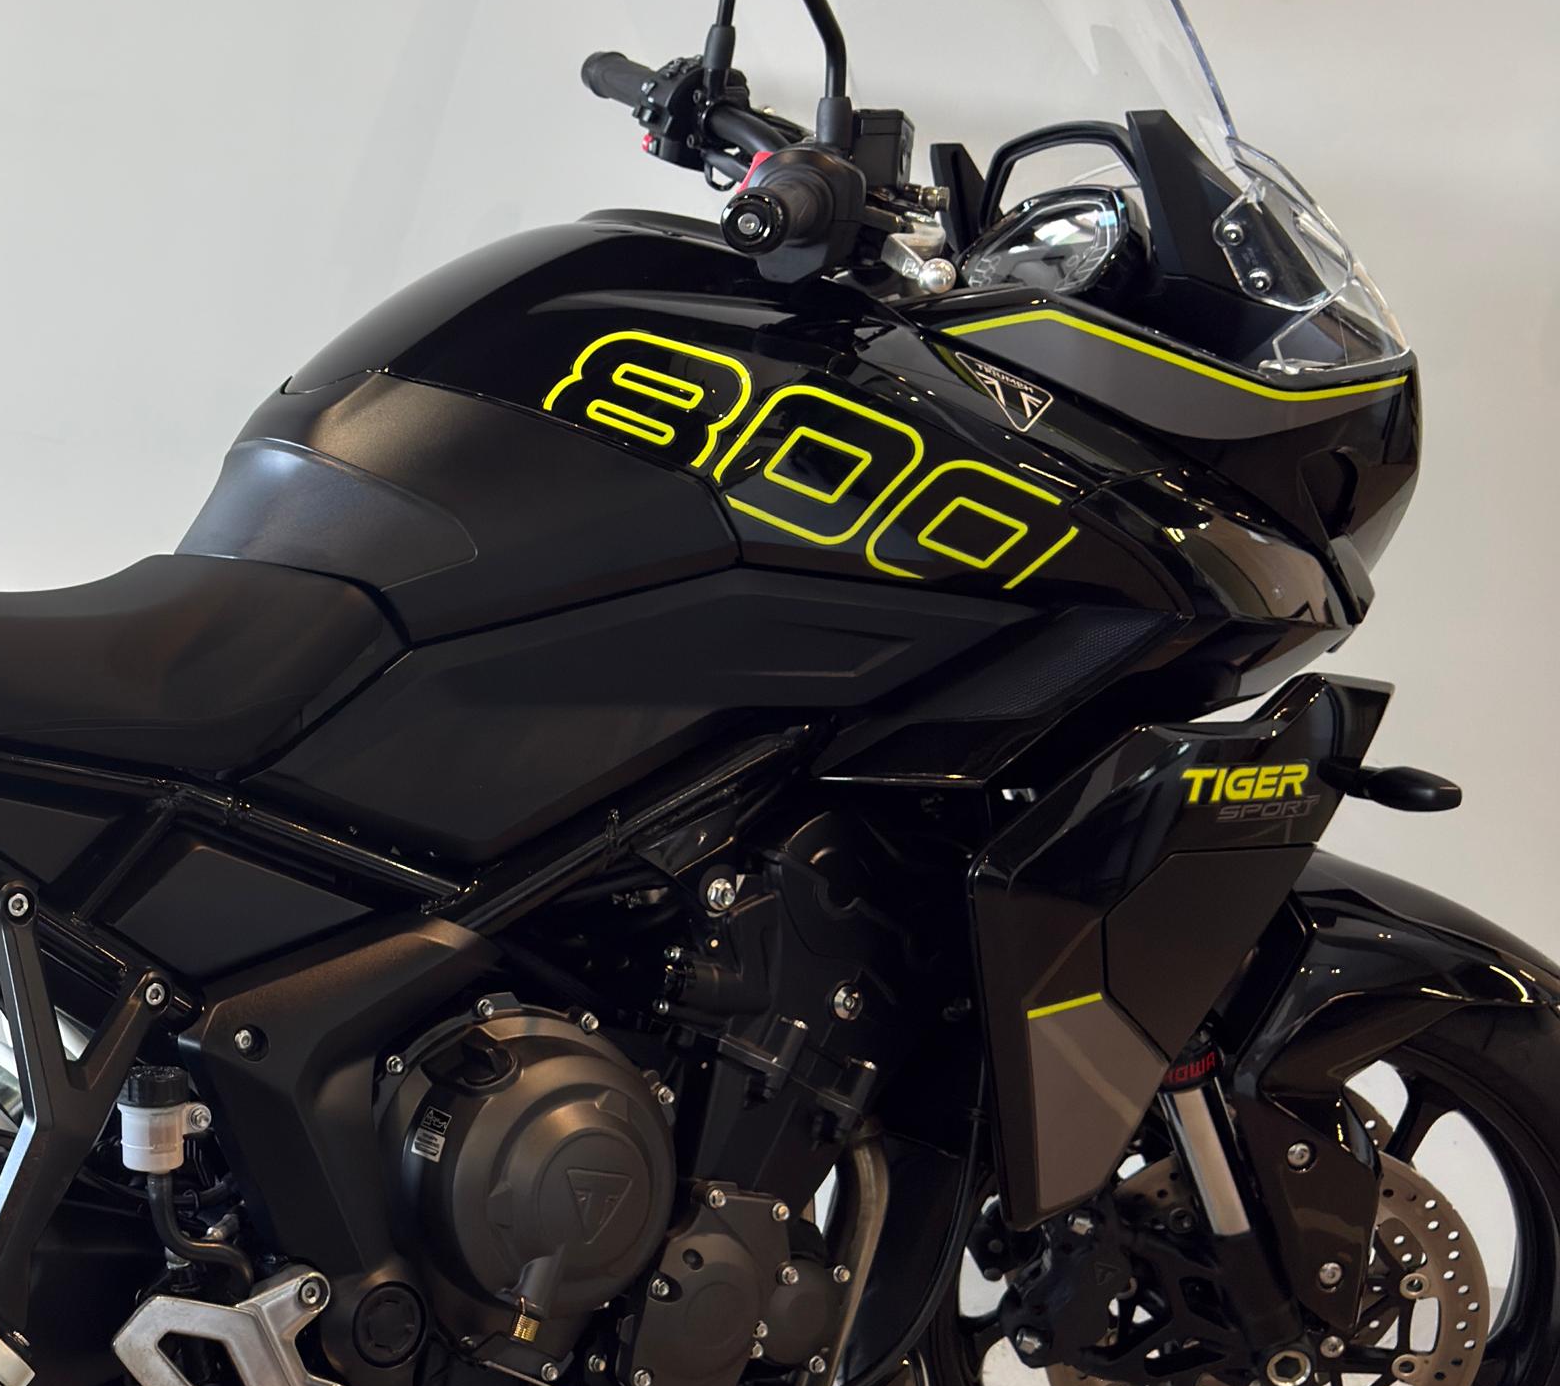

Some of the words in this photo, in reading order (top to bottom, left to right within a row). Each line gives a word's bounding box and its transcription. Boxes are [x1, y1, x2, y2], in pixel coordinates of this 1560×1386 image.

[975, 362, 1034, 394] TRIUMPH
[543, 332, 1080, 589] 800
[1182, 763, 1309, 804] TIGER
[1217, 795, 1320, 820] SPORT
[1164, 1051, 1216, 1083] HOWA
